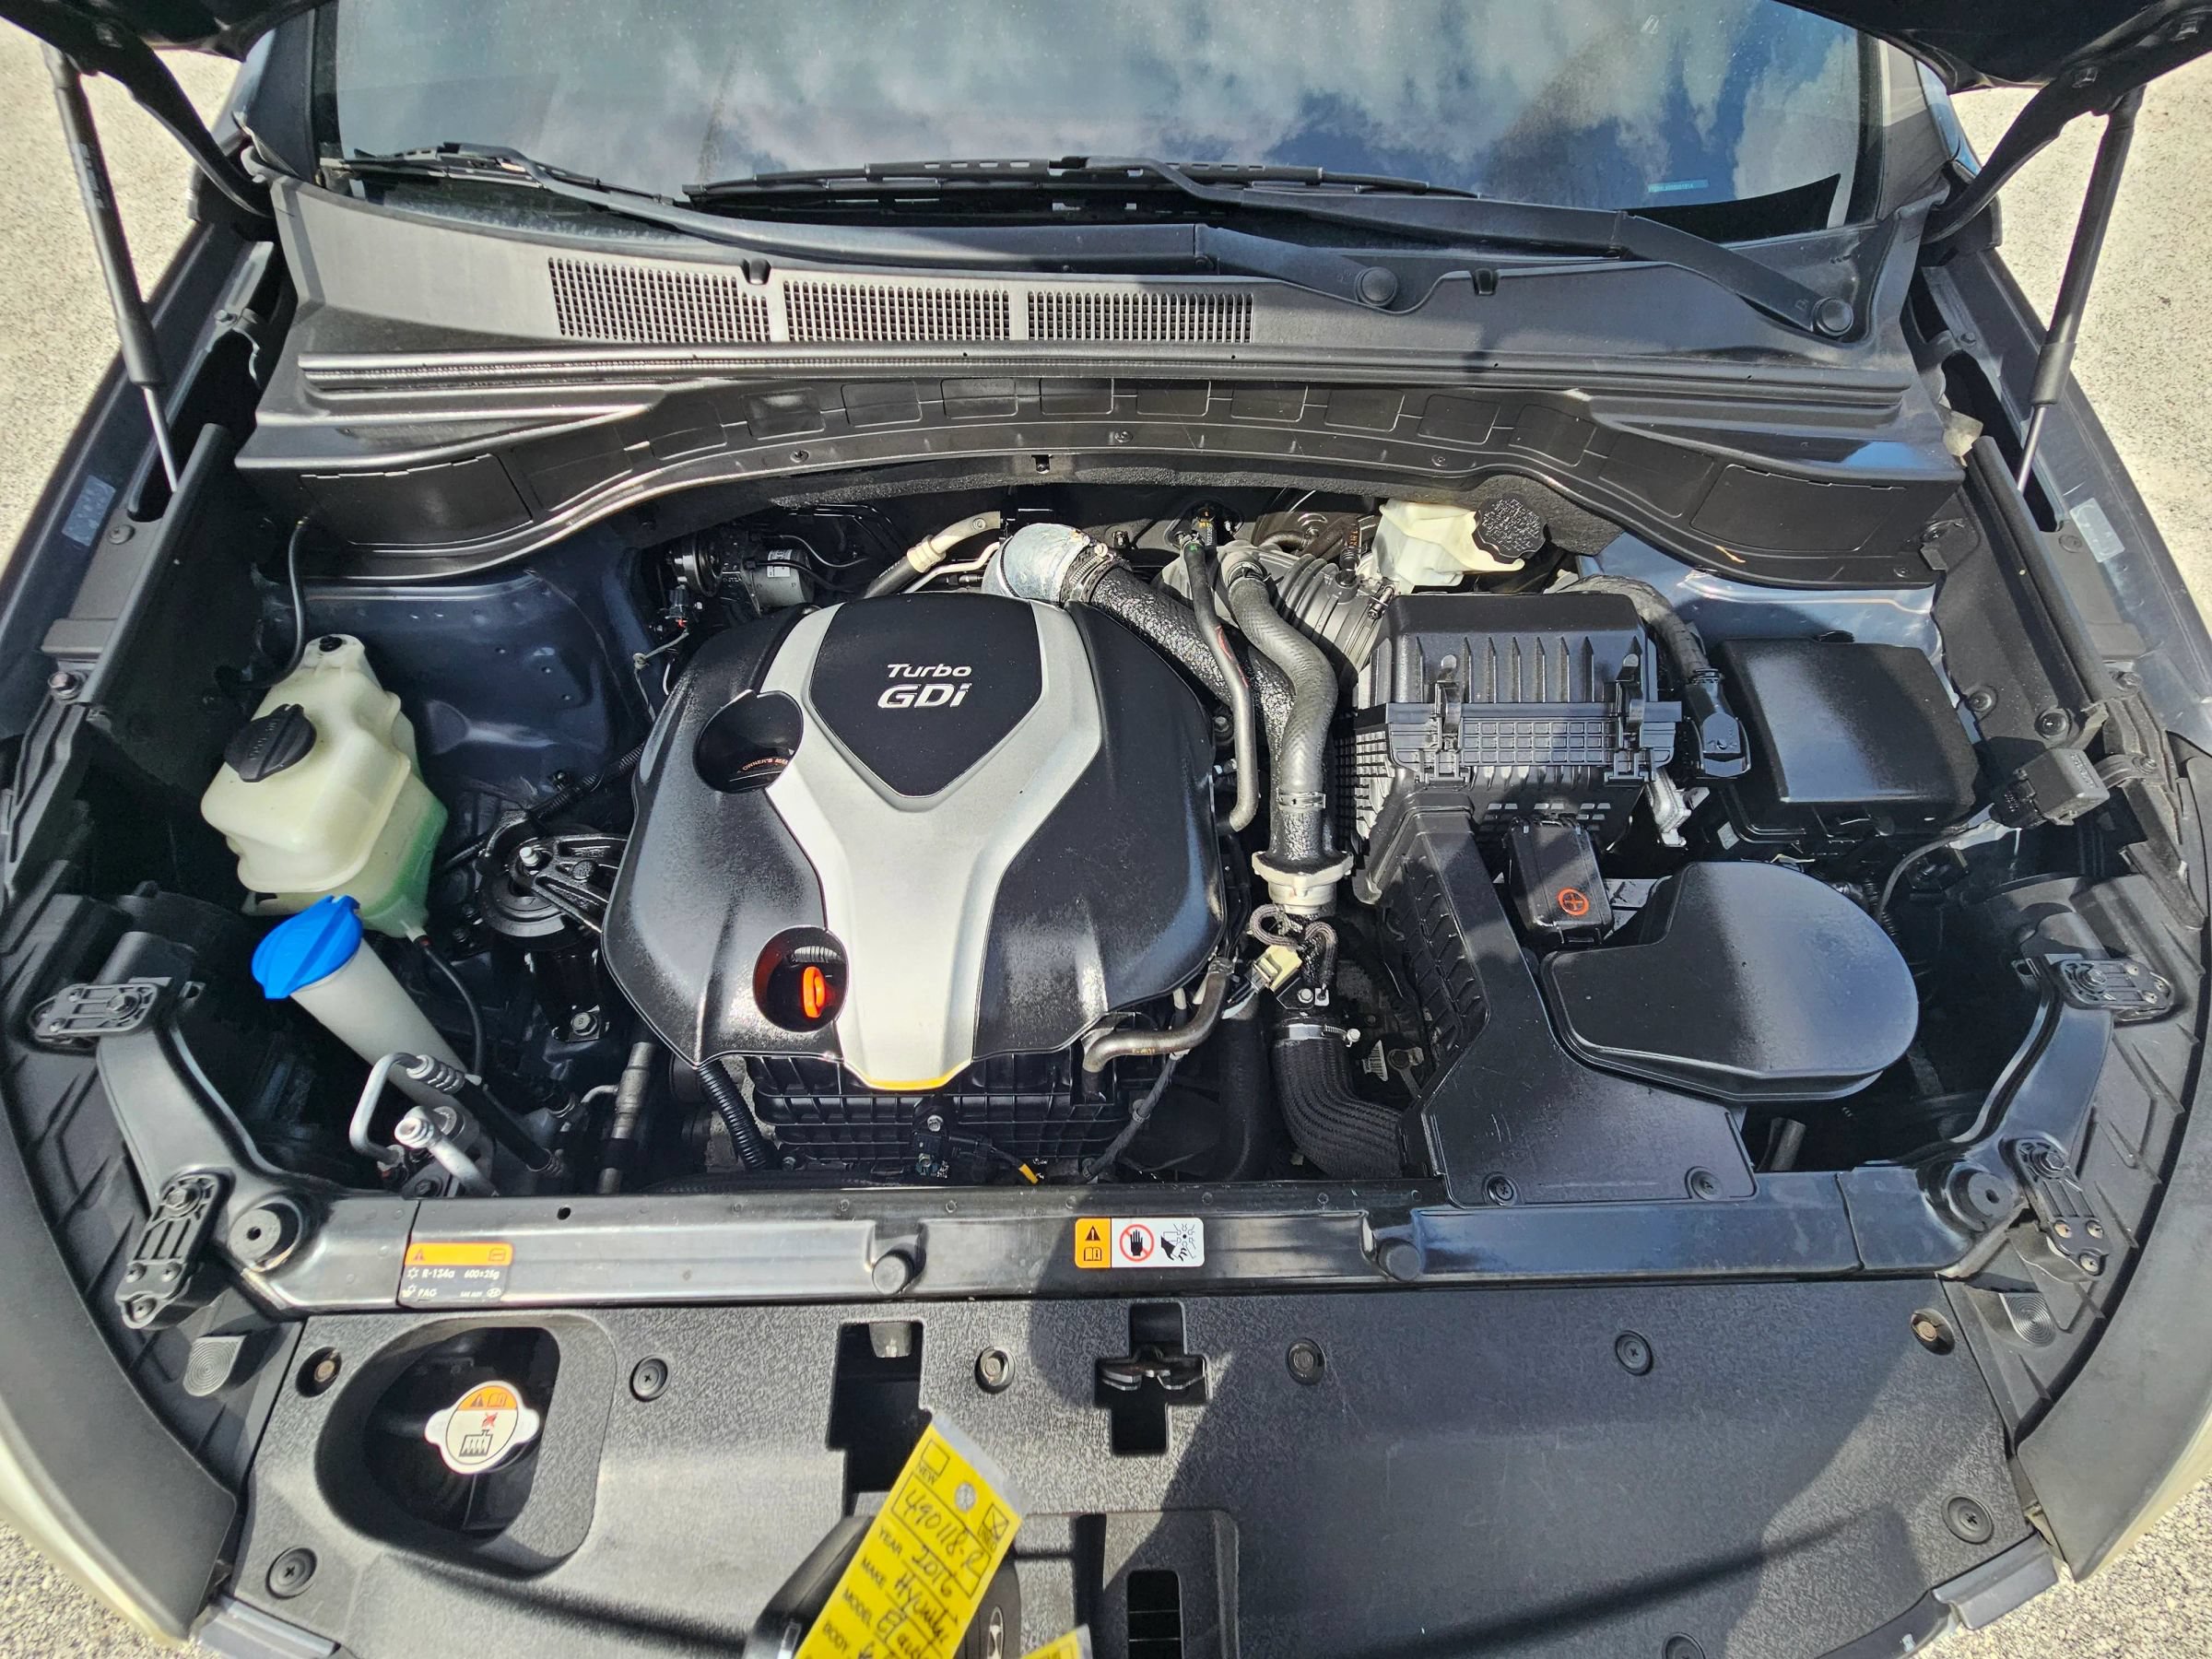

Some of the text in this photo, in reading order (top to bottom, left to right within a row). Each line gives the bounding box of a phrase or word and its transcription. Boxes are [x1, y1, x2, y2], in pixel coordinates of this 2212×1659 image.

[887, 663, 972, 678] Turbo
[877, 682, 973, 708] GDi
[915, 1464, 939, 1486] NEW
[878, 1527, 903, 1556] YEAR
[861, 1557, 887, 1590] MAKE
[842, 1587, 874, 1628] MODEL
[822, 1619, 850, 1652] BODY
